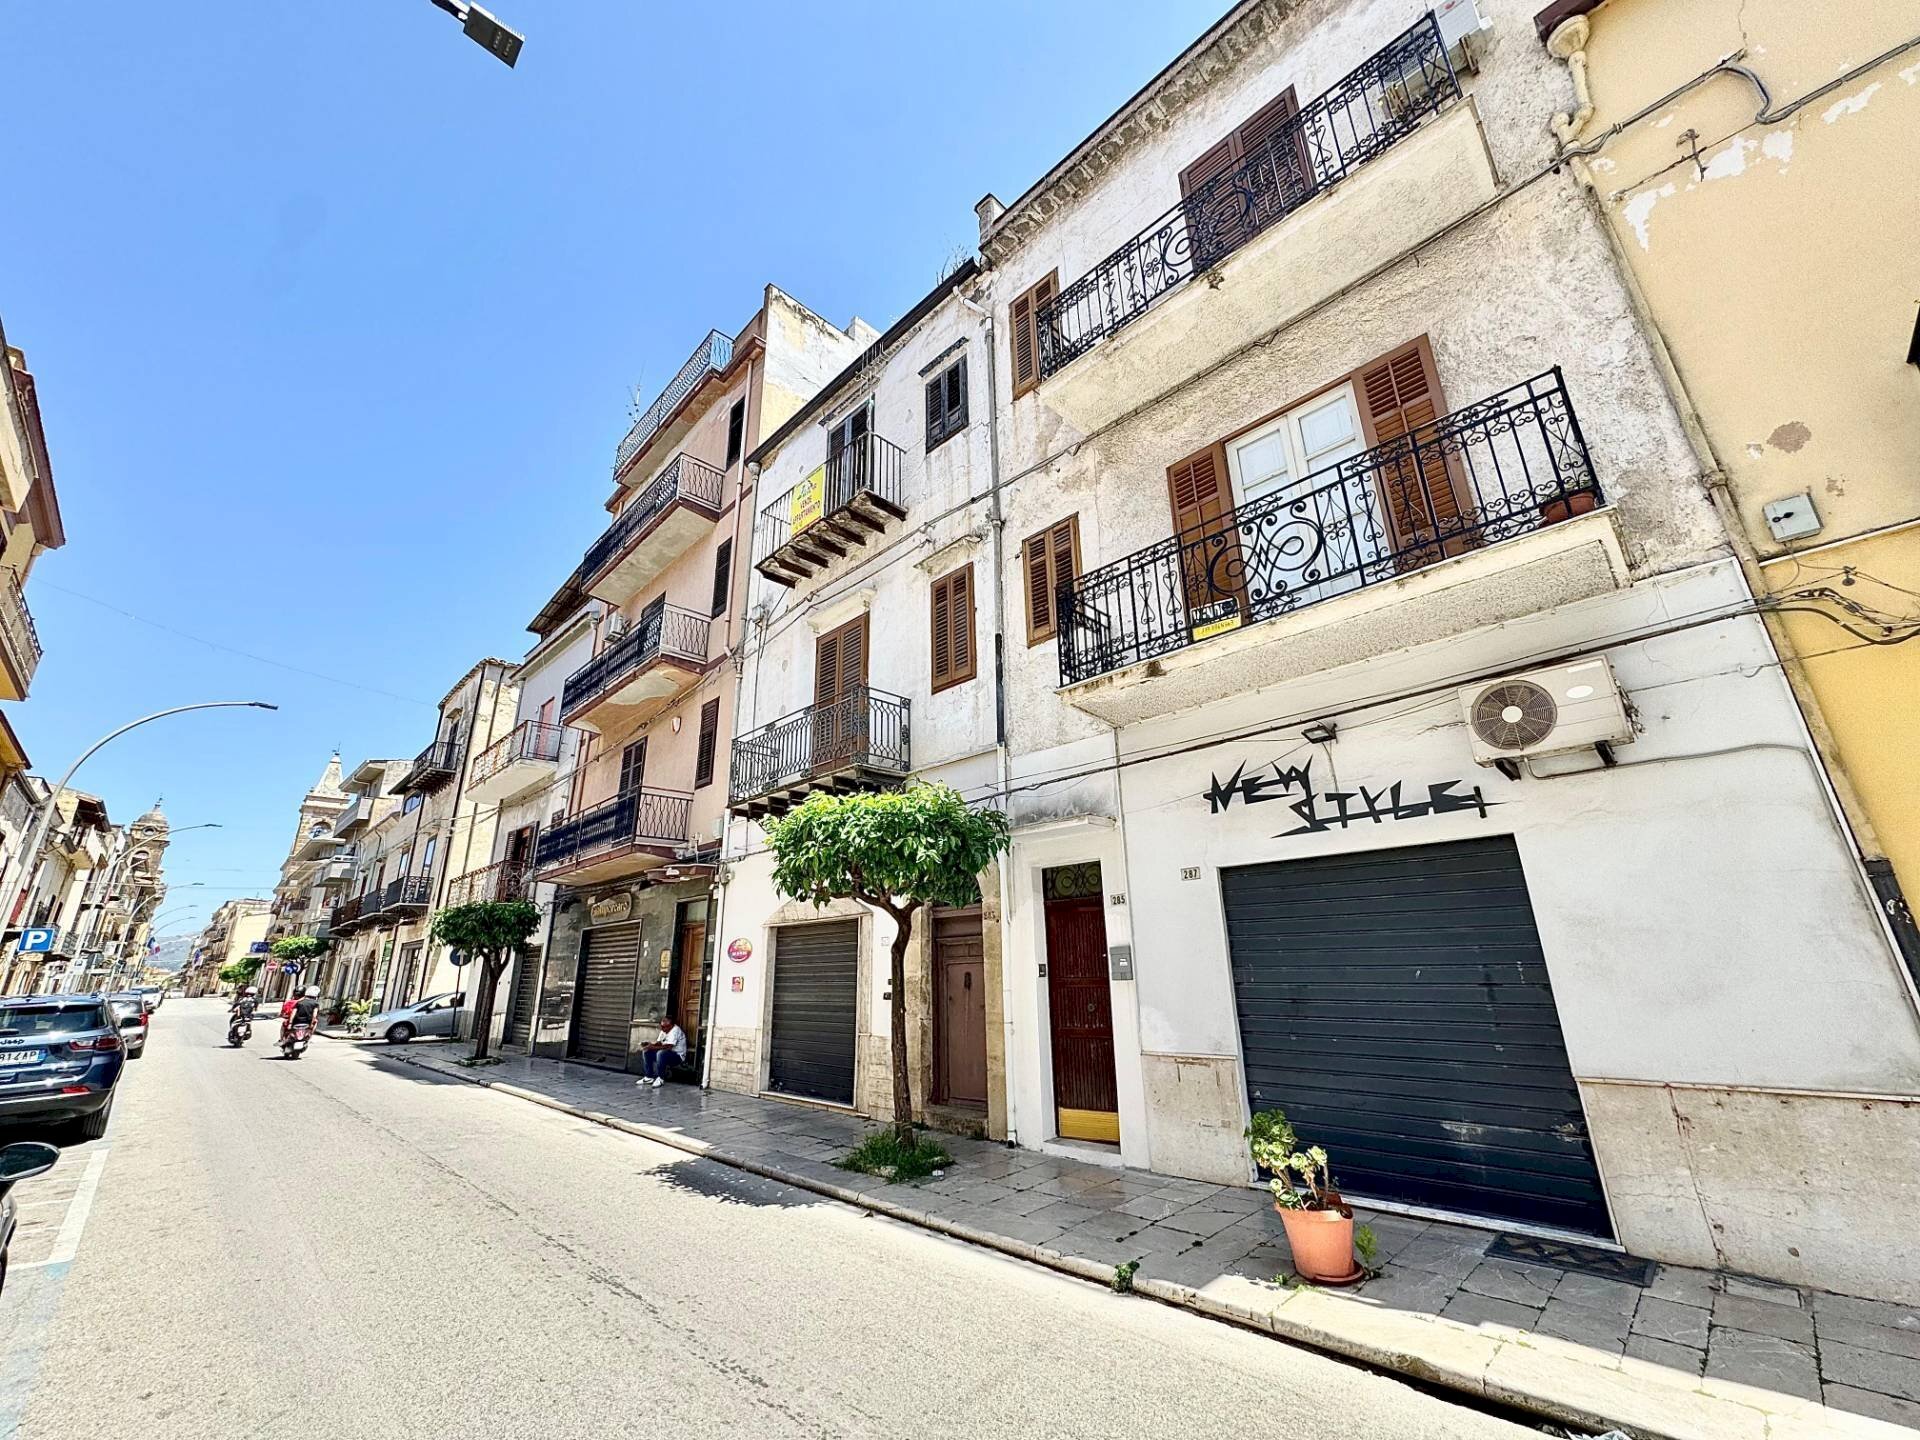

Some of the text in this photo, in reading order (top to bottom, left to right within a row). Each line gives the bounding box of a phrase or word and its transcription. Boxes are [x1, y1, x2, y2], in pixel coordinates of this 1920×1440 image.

[1203, 755, 1313, 814] NEW
[1271, 780, 1508, 838] STYLE
[1183, 869, 1198, 879] 287
[1112, 895, 1126, 905] 285
[25, 931, 48, 950] P
